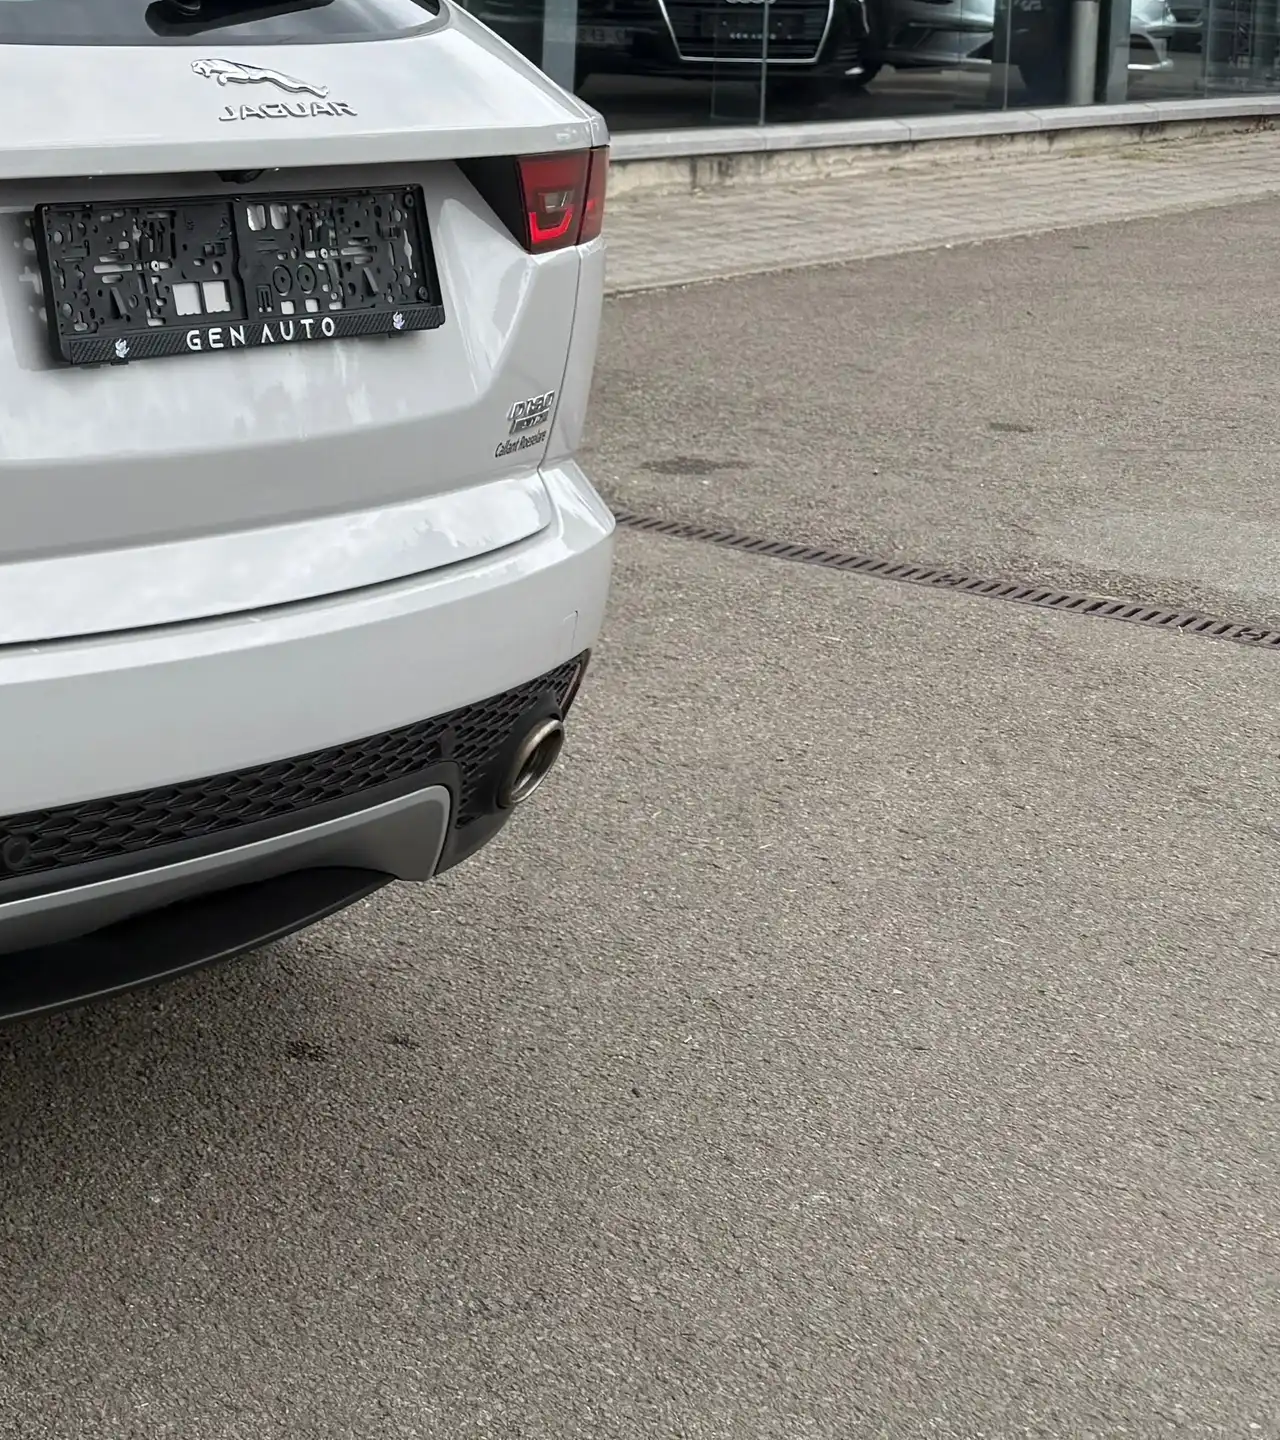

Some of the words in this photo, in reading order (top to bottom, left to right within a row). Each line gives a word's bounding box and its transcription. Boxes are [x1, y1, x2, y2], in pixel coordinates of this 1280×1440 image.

[218, 101, 358, 122] JAGUAR
[186, 324, 246, 351] GEN
[260, 316, 336, 344] AUTO
